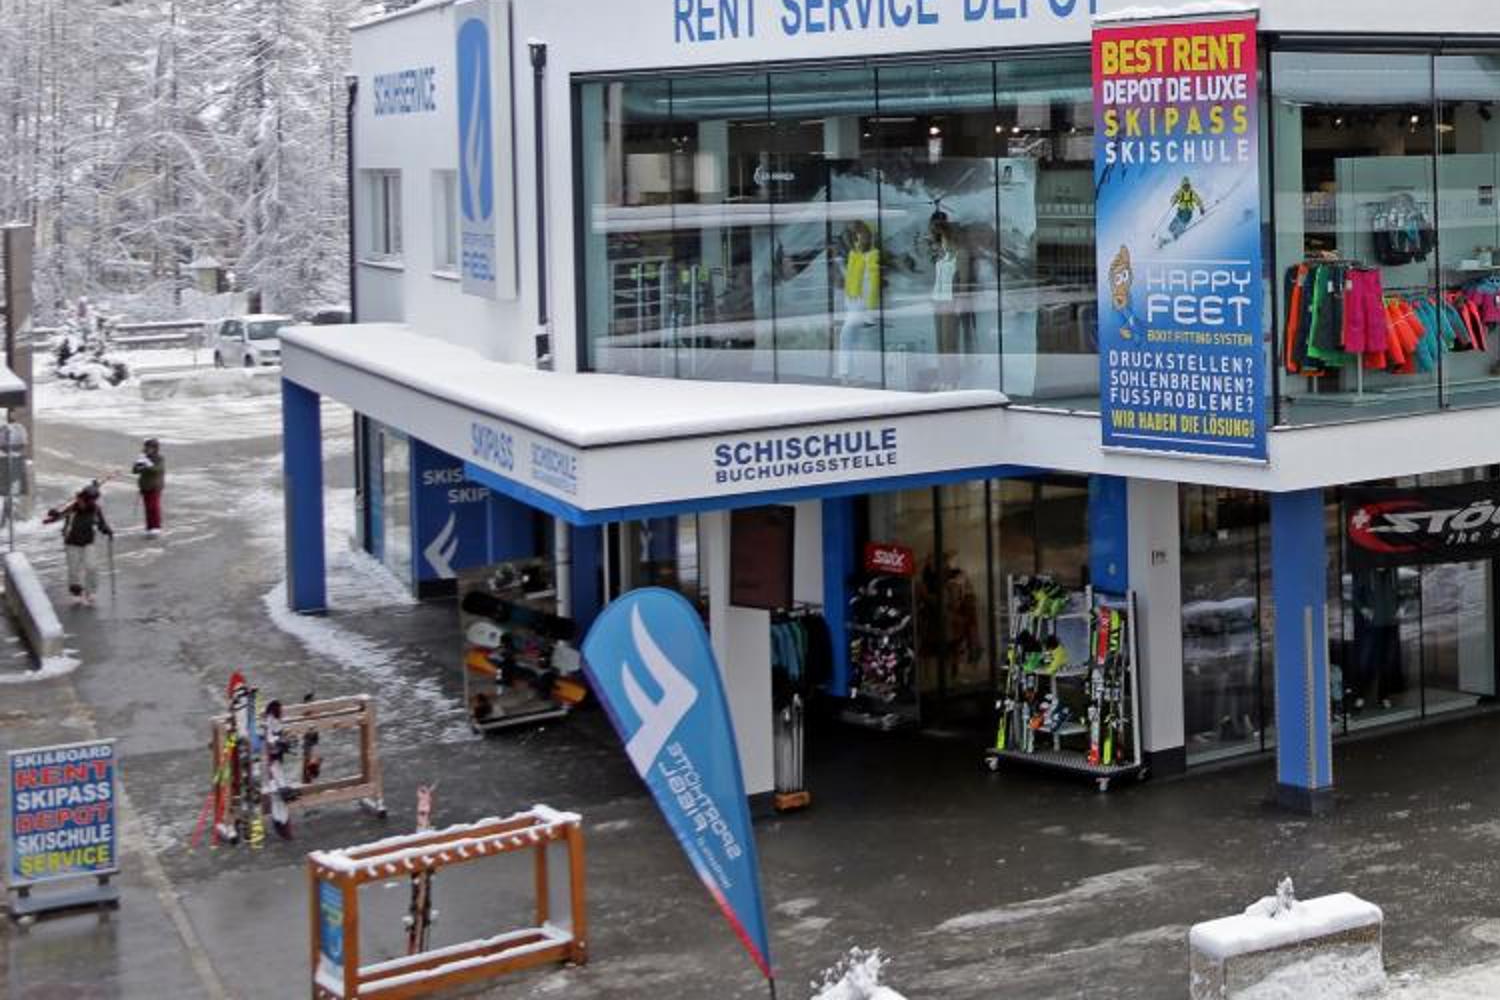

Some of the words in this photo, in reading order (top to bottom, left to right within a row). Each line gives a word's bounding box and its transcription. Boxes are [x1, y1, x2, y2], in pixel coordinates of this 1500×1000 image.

[1101, 37, 1168, 76] BEST
[1172, 33, 1246, 73] RENT
[1103, 77, 1163, 105] DEPOT
[1166, 76, 1193, 102] DE
[1195, 73, 1247, 101] LUXE
[1103, 104, 1248, 137] SKIPASS
[1105, 139, 1249, 164] SKISCHULE
[1147, 269, 1251, 293] HAPPY
[1147, 294, 1251, 327] FEET
[1109, 350, 1253, 374] DRUCKSTELLEN?
[1110, 369, 1254, 395] SOHLENBRENNEN?
[1110, 387, 1254, 413] FUSSPROBLEME?
[1112, 410, 1135, 428] WIR
[1138, 411, 1177, 432] HABEN
[1181, 415, 1200, 433] DIE
[714, 428, 897, 468] SCHISCHULE
[715, 451, 897, 484] BUCHUNGSSTELLE
[15, 759, 108, 791] RENT
[16, 781, 111, 812] SKIPASS
[15, 801, 108, 835] DEPOT
[16, 823, 112, 856] SKISCHULE
[20, 844, 111, 877] SERVICE
